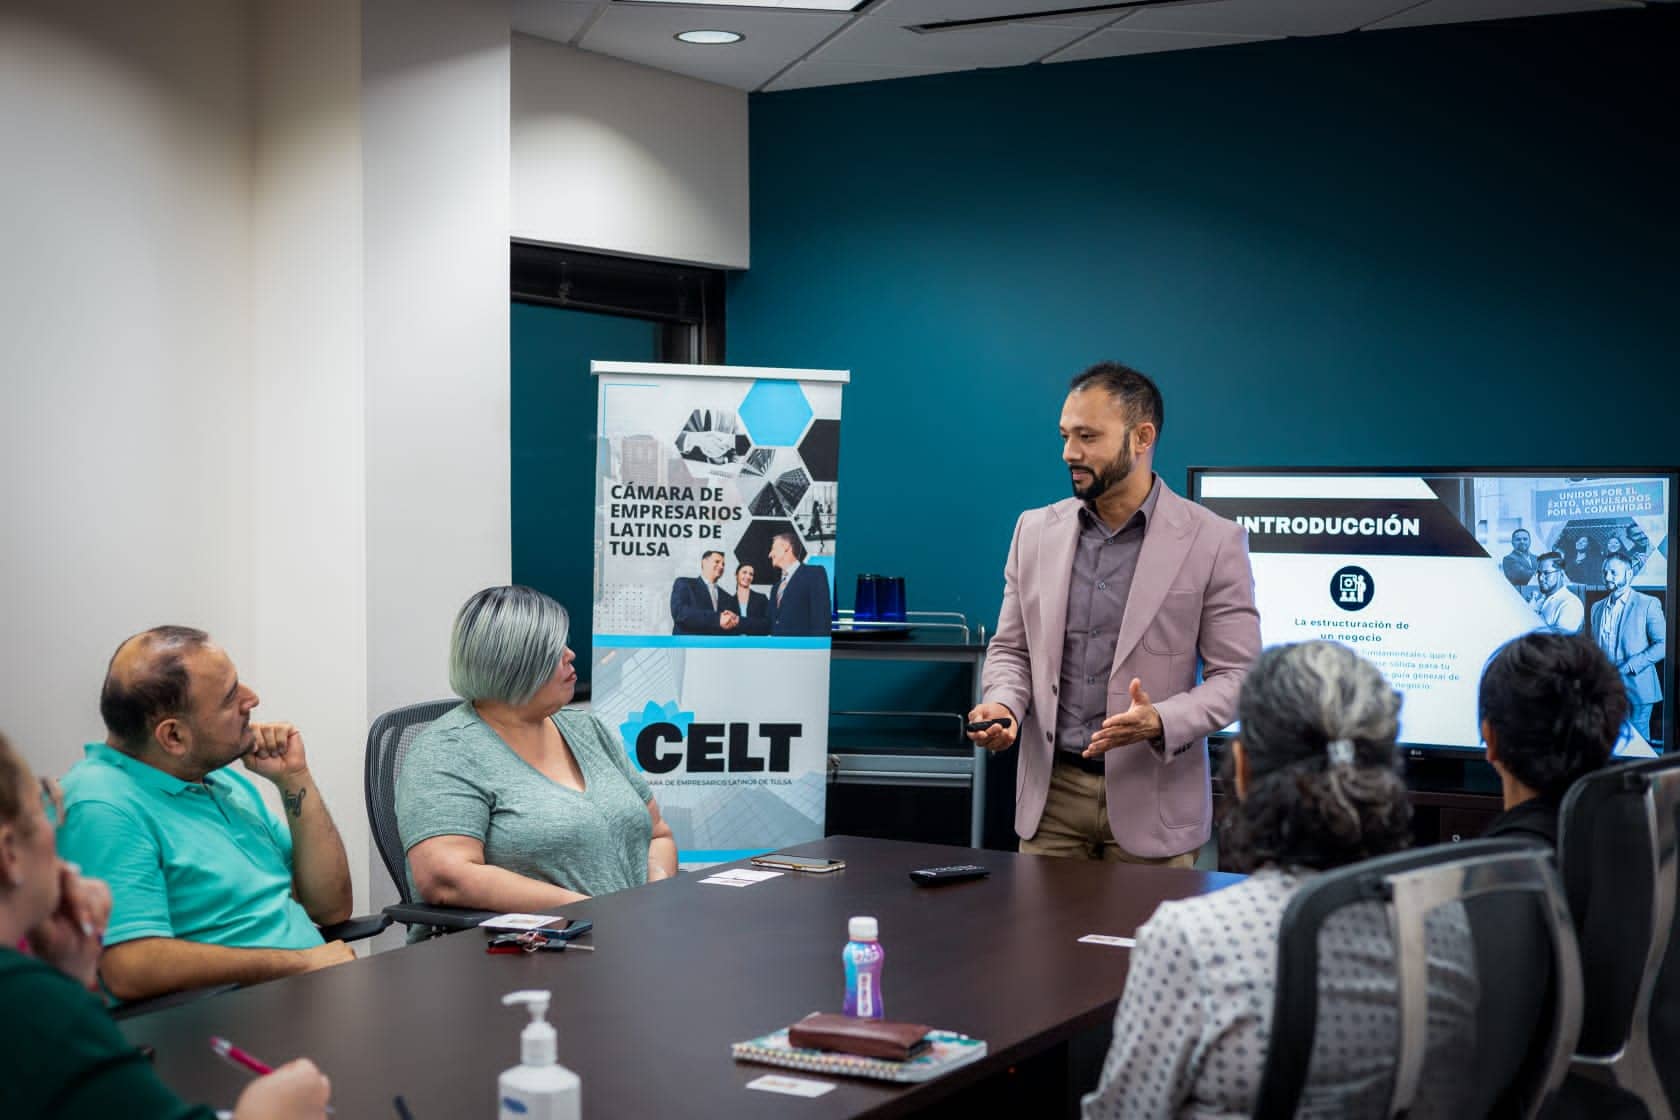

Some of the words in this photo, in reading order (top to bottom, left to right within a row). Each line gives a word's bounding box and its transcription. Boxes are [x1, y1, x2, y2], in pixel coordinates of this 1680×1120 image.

[610, 481, 694, 501] CÁMARA
[700, 487, 723, 502] DE
[1560, 489, 1599, 500] UNIDOS
[1601, 487, 1623, 497] POR
[1625, 487, 1637, 495] EL
[1582, 494, 1652, 506] IMPULSADOS
[610, 503, 742, 521] EMPRESARIOS
[1547, 508, 1568, 517] POR
[1569, 507, 1582, 516] LA
[1584, 502, 1652, 514] COMUNIDAD
[609, 522, 693, 539] LATINOS
[699, 524, 722, 539] DE
[609, 541, 670, 557] TULSA
[1294, 618, 1306, 627] La
[1310, 619, 1392, 630] estructuración
[1396, 621, 1409, 630] de
[1320, 633, 1334, 641] un
[1338, 633, 1382, 643] negocio
[635, 721, 802, 774] CELT
